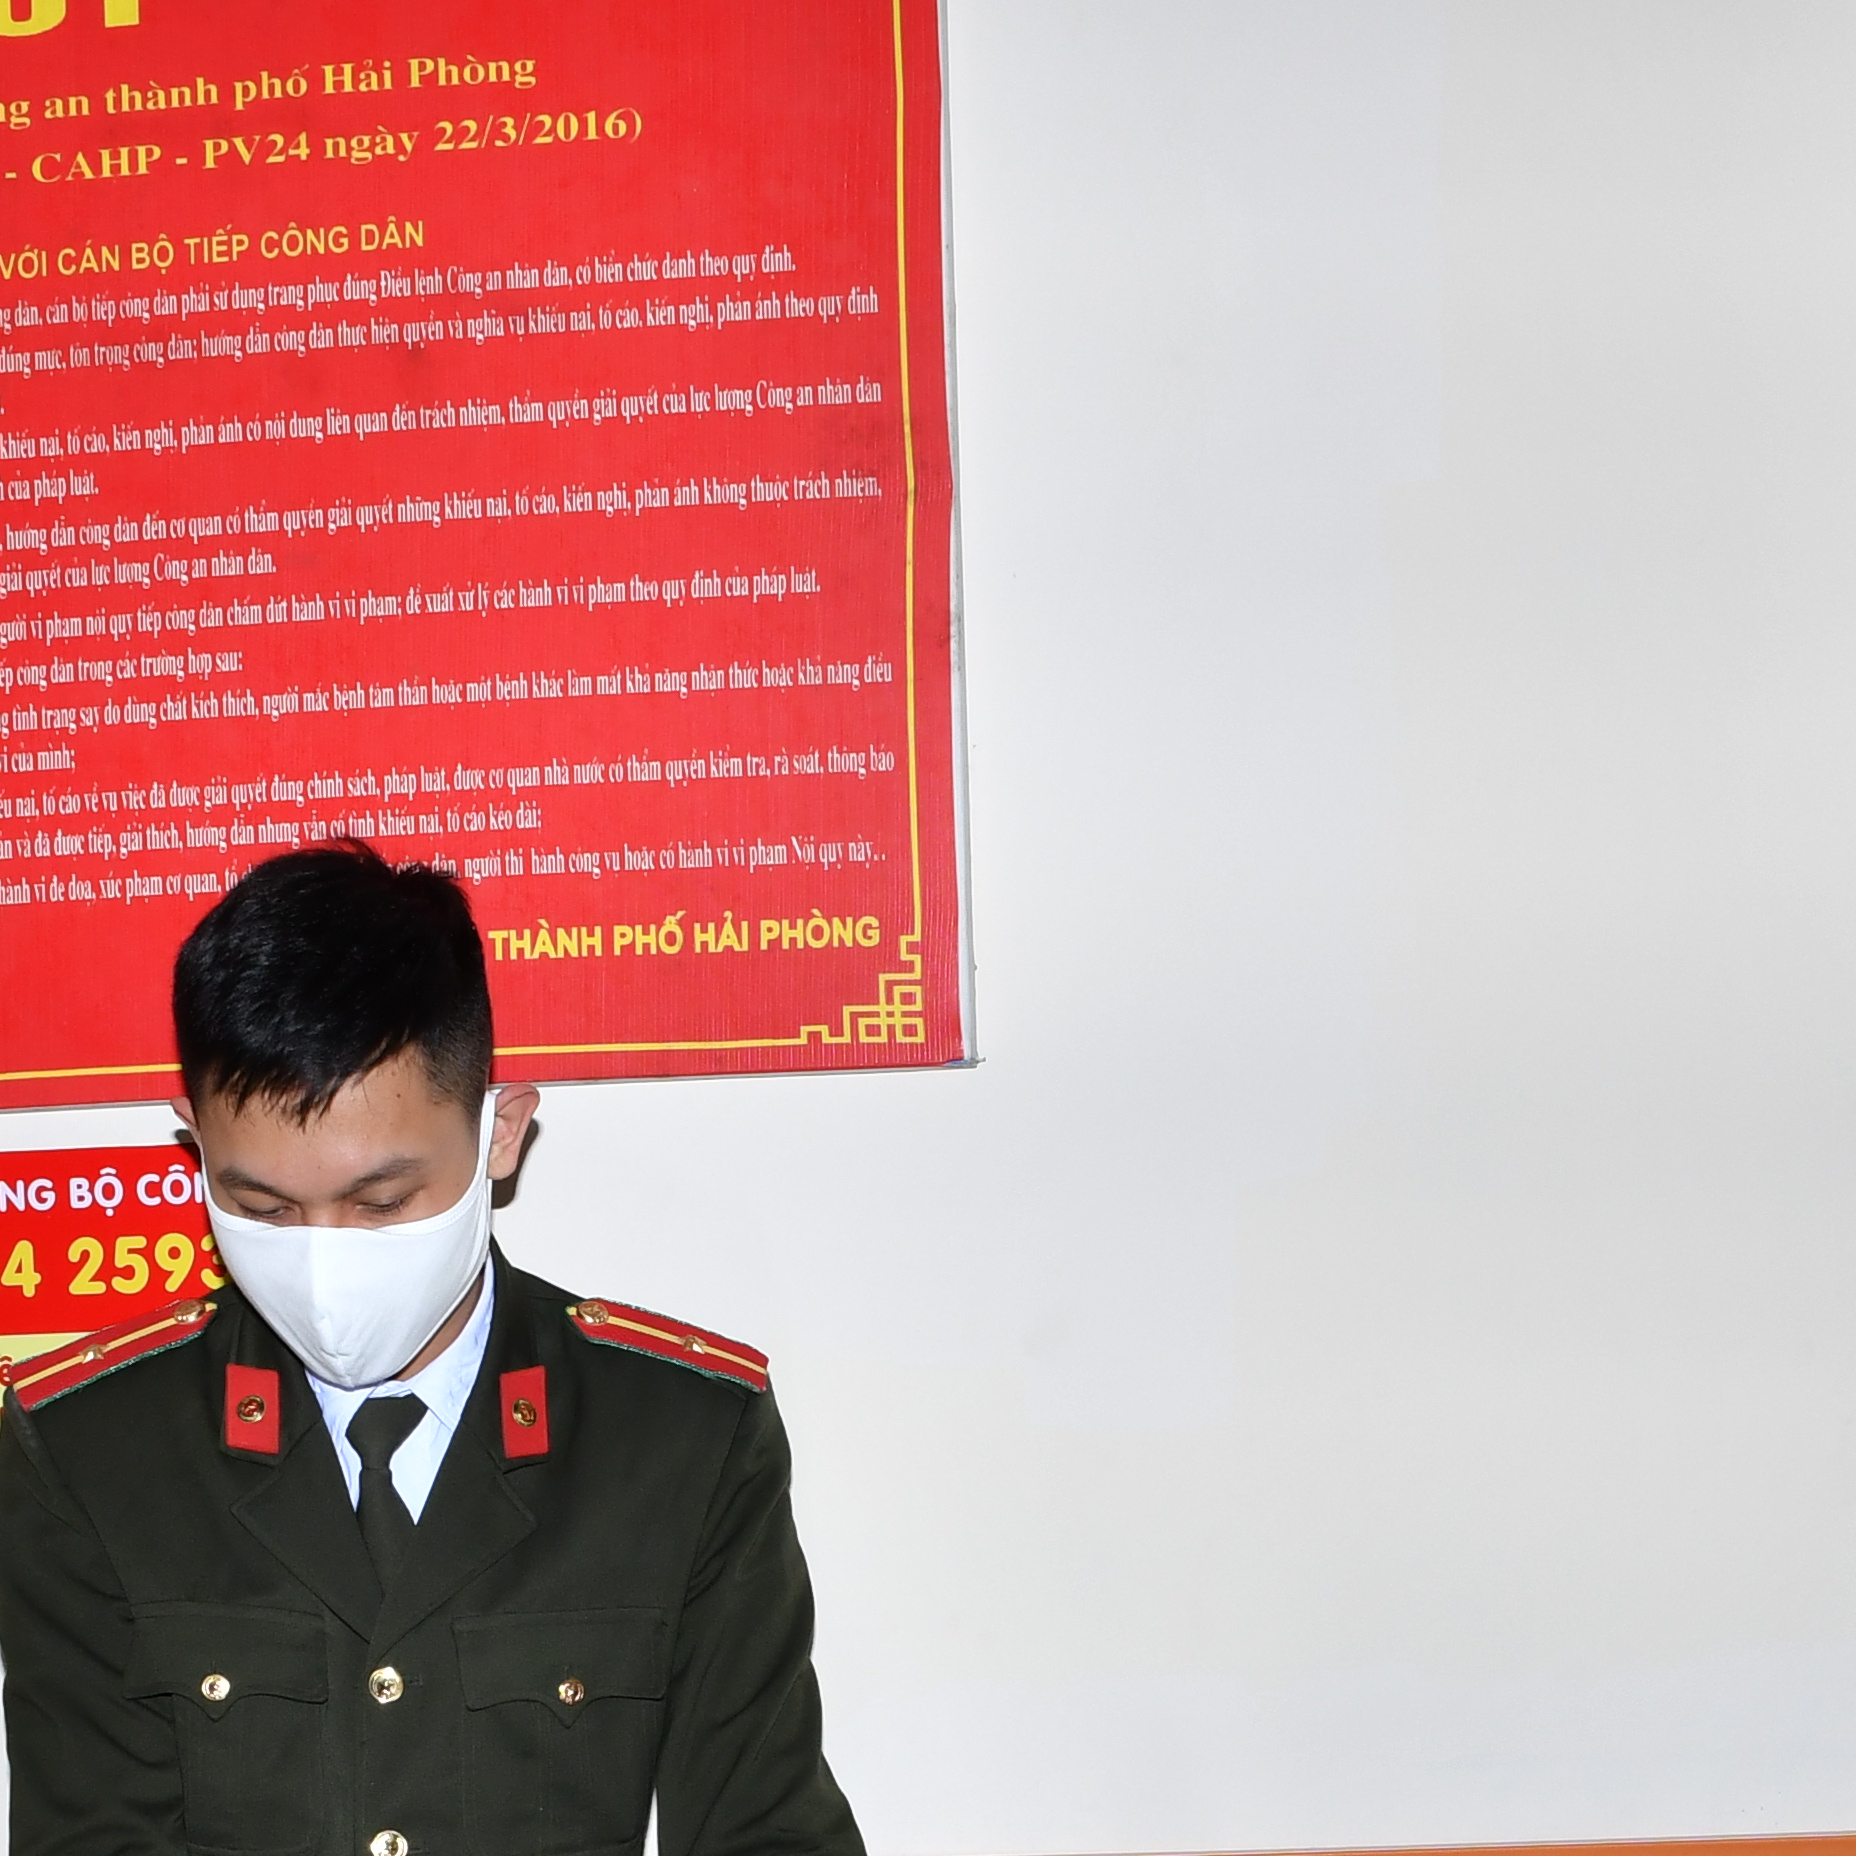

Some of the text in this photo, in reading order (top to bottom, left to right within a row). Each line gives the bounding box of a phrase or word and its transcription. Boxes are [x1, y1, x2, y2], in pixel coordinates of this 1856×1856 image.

[44, 94, 90, 120] an
[104, 75, 219, 115] thành
[233, 64, 309, 112] phố
[321, 58, 393, 95] Hải
[407, 53, 537, 90] Phòng
[31, 143, 162, 184] CAHP
[203, 130, 311, 170] PV24
[324, 124, 419, 166] ngày
[434, 107, 642, 152] 22/3/2016)
[57, 238, 120, 277] CÁN
[131, 232, 175, 276] BỘ
[183, 223, 250, 266] TIẾP
[260, 221, 349, 260] CÔNG
[360, 214, 424, 252] DÂN
[487, 907, 880, 962] THÀNH PHỐ HẢI PHÒNG
[69, 1166, 124, 1217] BỘ
[136, 1163, 202, 1207] CÔ
